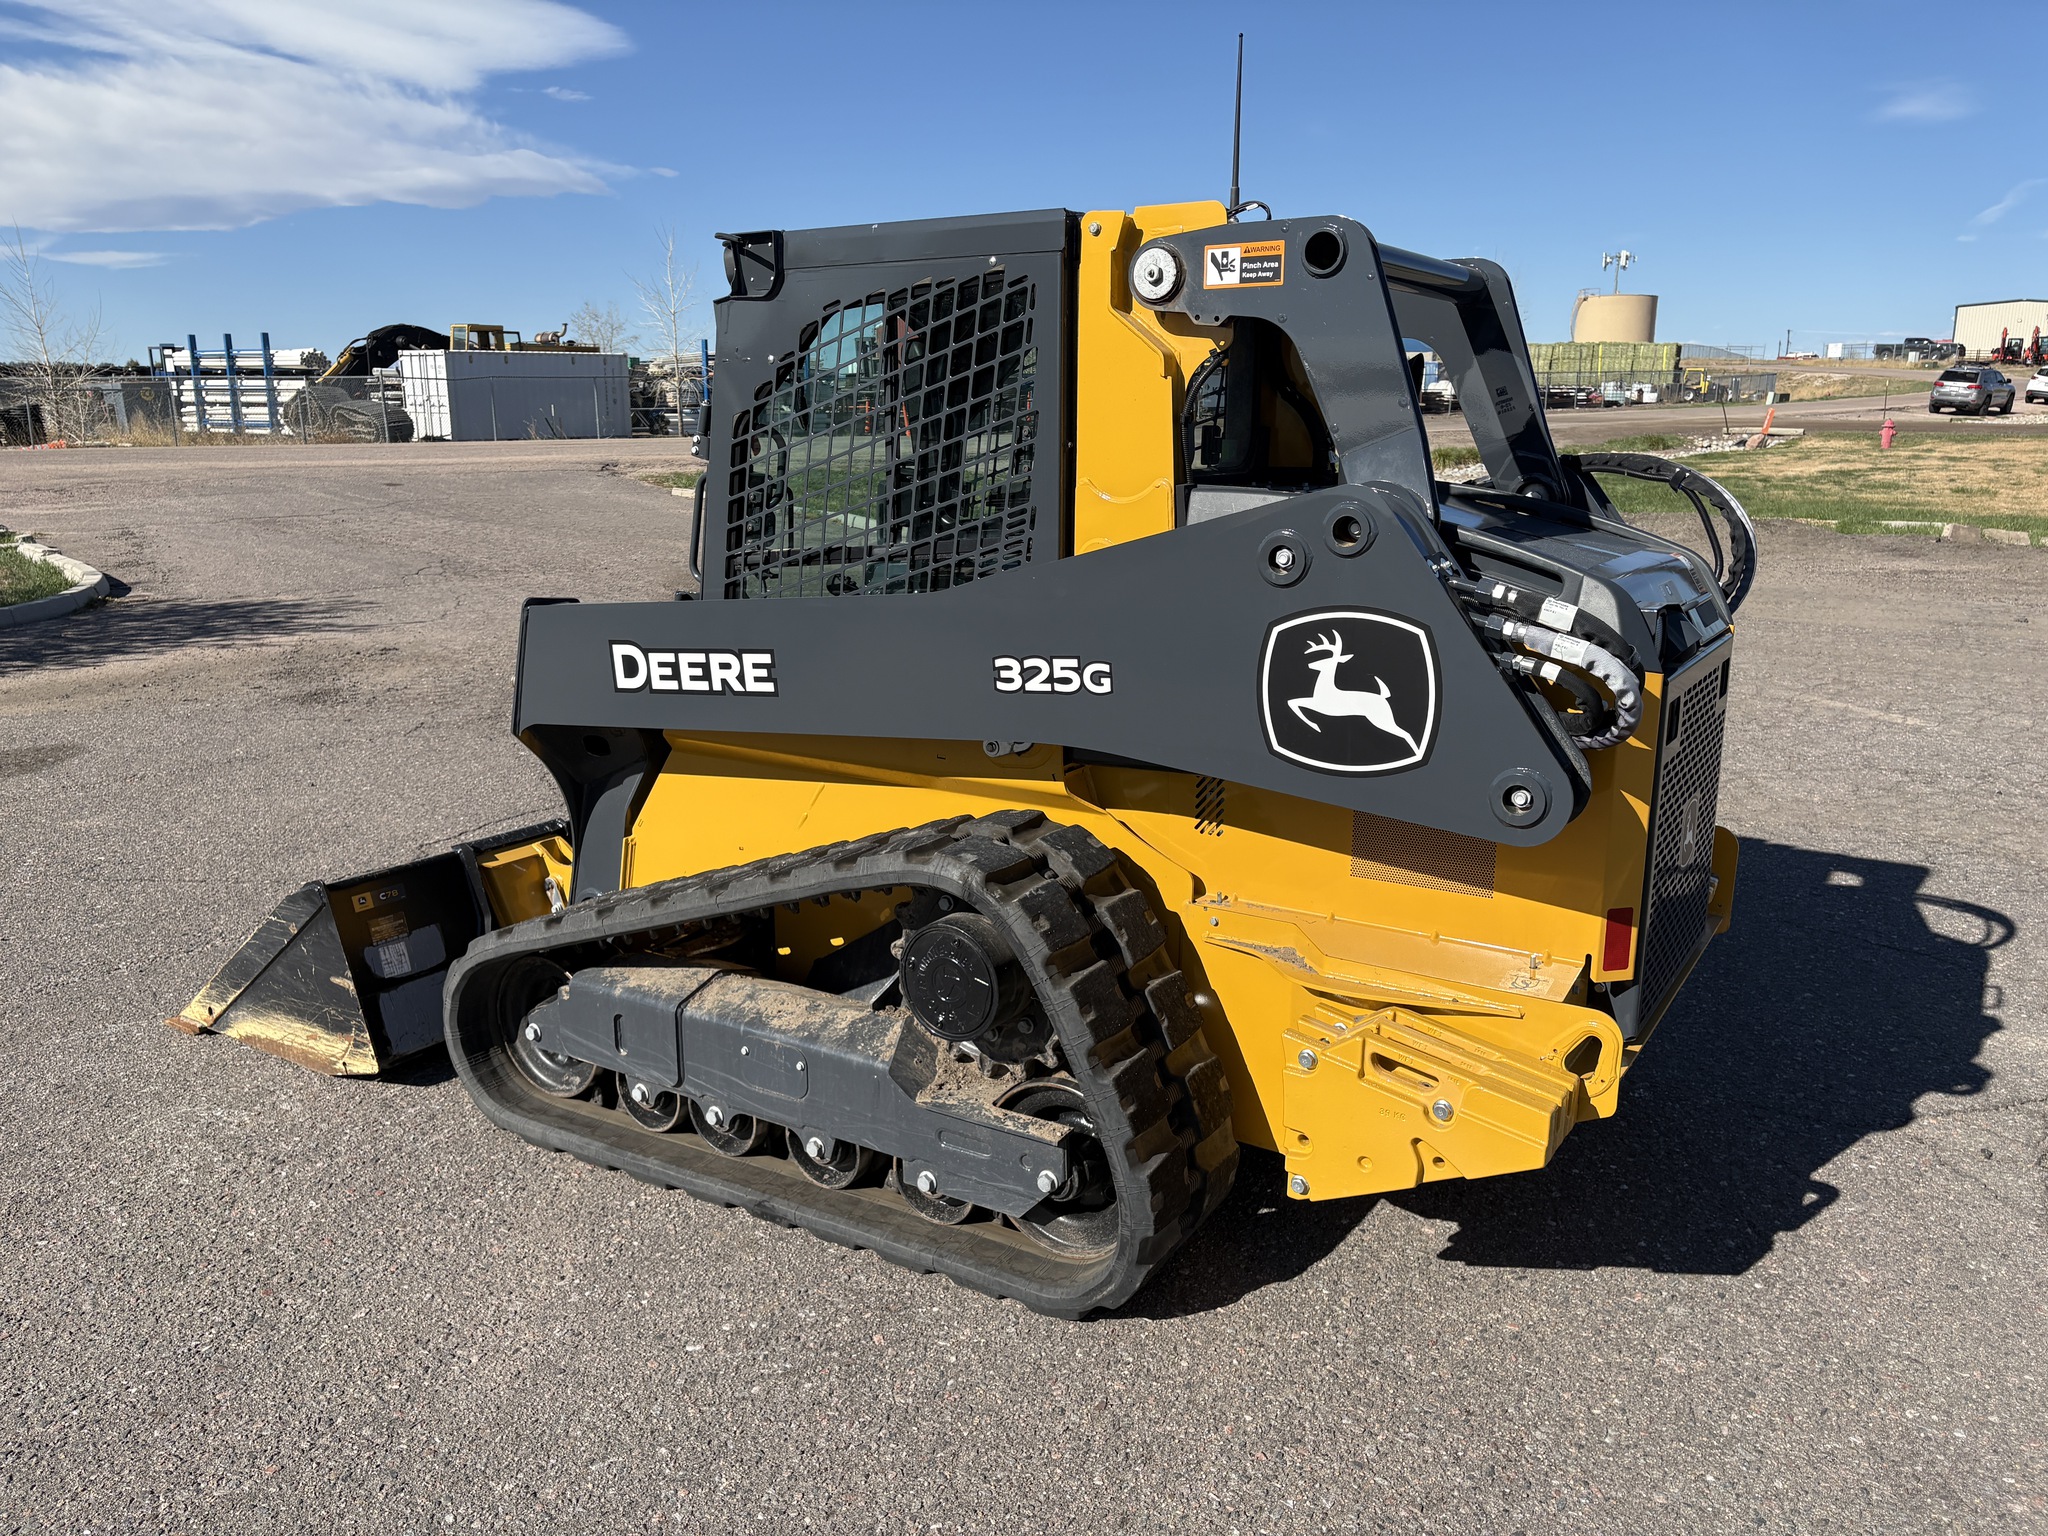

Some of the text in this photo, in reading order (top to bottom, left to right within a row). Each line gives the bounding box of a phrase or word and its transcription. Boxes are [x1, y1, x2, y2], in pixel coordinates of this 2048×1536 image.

[1250, 245, 1280, 253] WARNING
[1242, 271, 1257, 279] Keep
[611, 644, 775, 693] DEERE
[995, 657, 1112, 694] 325G
[379, 889, 399, 901] C78
